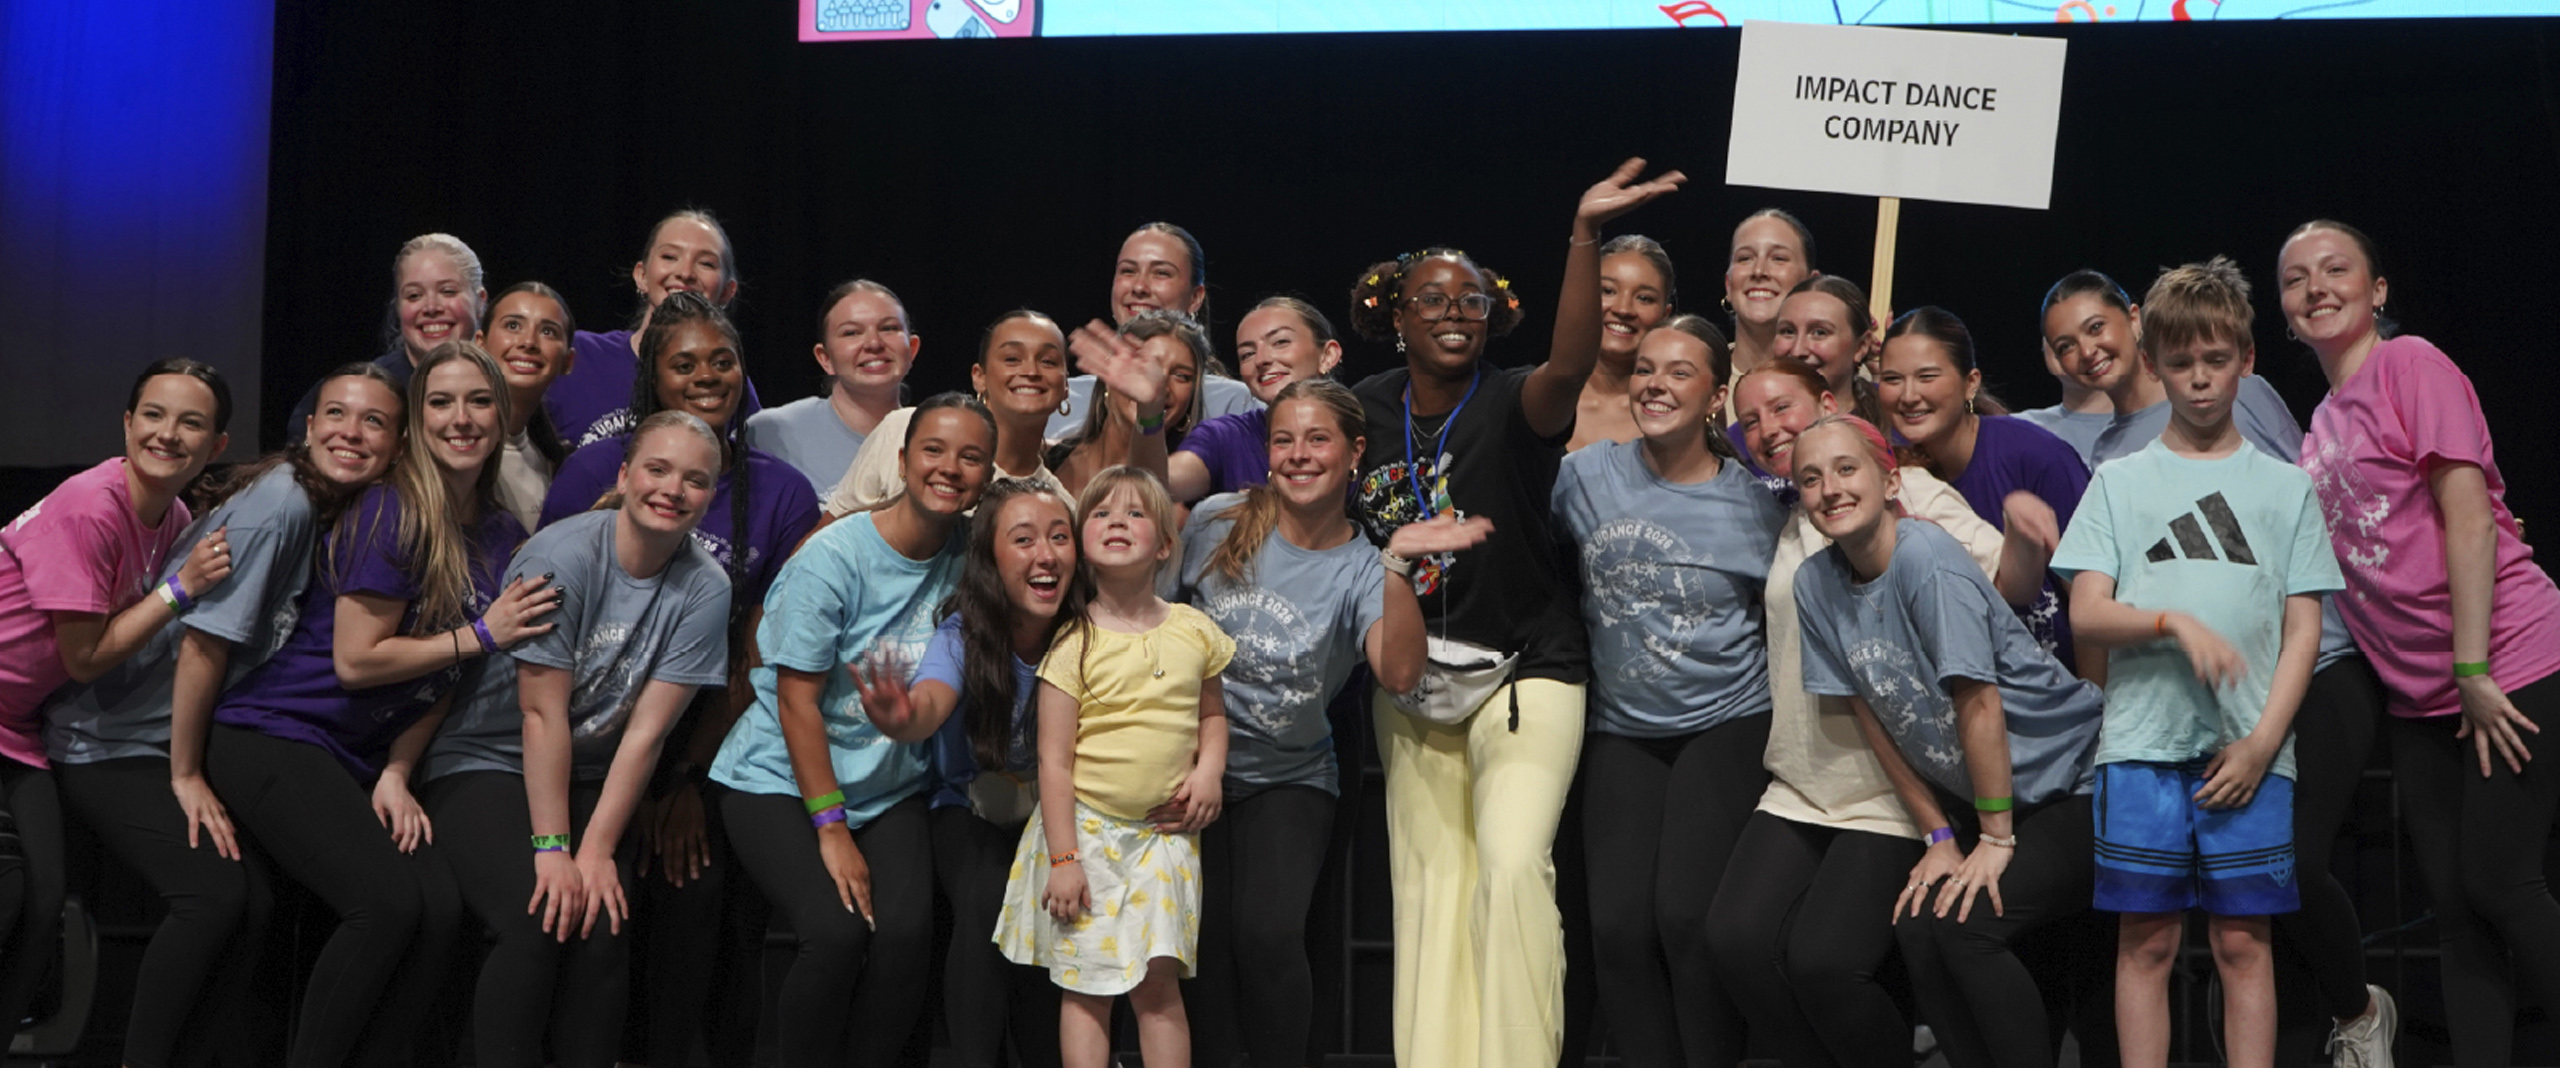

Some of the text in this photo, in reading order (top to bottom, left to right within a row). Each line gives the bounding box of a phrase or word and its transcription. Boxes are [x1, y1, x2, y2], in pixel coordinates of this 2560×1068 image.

[1795, 75, 1997, 111] IMPACT DANCE
[1824, 115, 1960, 147] COMPANY
[1593, 524, 1642, 547] UDANCE
[1643, 527, 1675, 550] 2026
[1215, 592, 1265, 612] UDANCE
[1265, 597, 1295, 624] 2026
